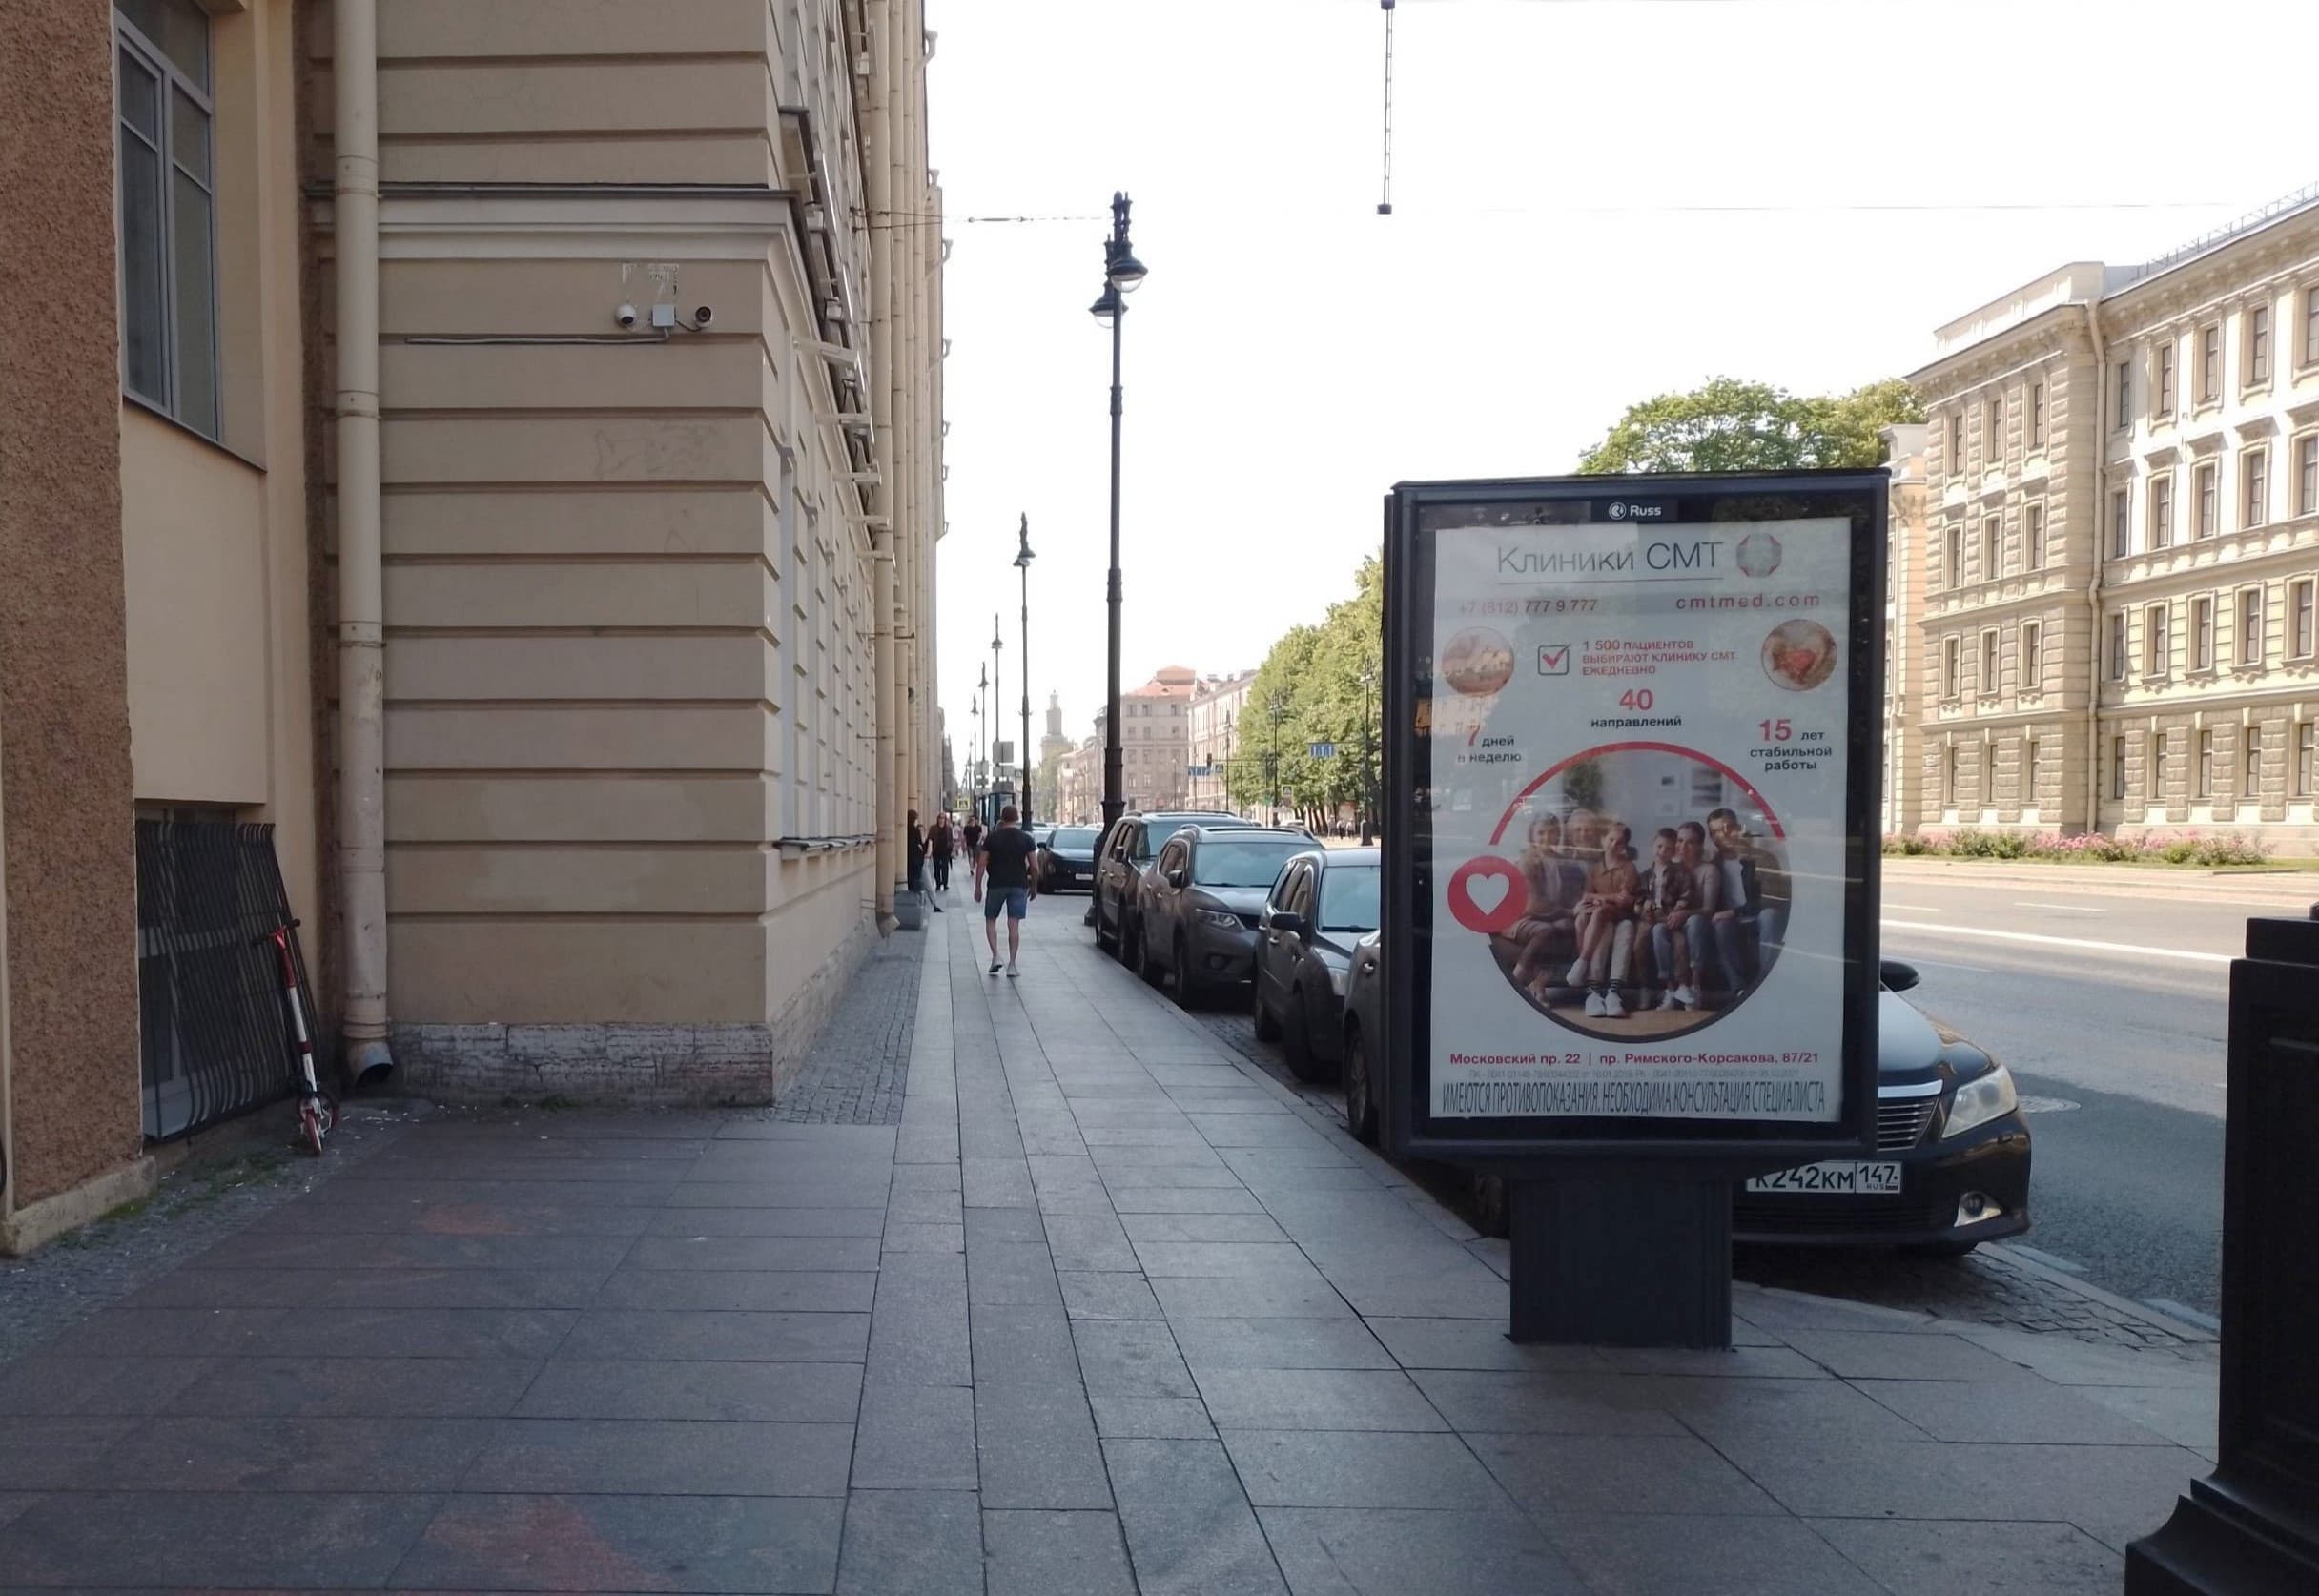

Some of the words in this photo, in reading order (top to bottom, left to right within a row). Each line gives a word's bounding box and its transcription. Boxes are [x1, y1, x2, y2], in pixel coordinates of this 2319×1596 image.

[1630, 505, 1662, 517] Russ
[1498, 546, 1634, 573] Клиники
[1646, 542, 1723, 570] СМТ
[1526, 601, 1550, 612] 777
[1556, 600, 1566, 612] 9
[1571, 599, 1598, 611] 777
[1675, 594, 1820, 610] cmtmed.com
[1595, 640, 1621, 650] 500
[1623, 640, 1694, 652] ПАЦИЕНТОВ
[1582, 654, 1649, 664] ВЫБИРАЮТ
[1652, 652, 1708, 663] КЛИНИКУ
[1711, 651, 1736, 661] СМТ
[1582, 666, 1656, 676] ЕЖЕДНЕВНО
[1619, 688, 1653, 711] 40
[1590, 715, 1682, 729] направлений
[1467, 722, 1481, 746] 7
[1482, 735, 1515, 747] дней
[1759, 719, 1792, 741] 15
[1800, 731, 1825, 741] лет
[1750, 746, 1832, 757] стабильной
[1469, 753, 1522, 764] неделю
[1764, 760, 1817, 773] работы
[1450, 1053, 1536, 1065] Московский
[1541, 1056, 1561, 1066] пр.
[1565, 1054, 1580, 1064] 22
[1600, 1056, 1621, 1066] пр.
[1625, 1053, 1778, 1065] Римского-Корсакова,
[1783, 1053, 1818, 1063] 87/21
[1443, 1083, 1491, 1113] ИМЕЮТСЯ
[1494, 1083, 1600, 1114] ПРОТИВОПОКАЗАНИЯ.
[1604, 1082, 1671, 1115] НЕОБХОДИМА
[1674, 1081, 1750, 1114] КОНСУЛЬТАЦИЯ
[1754, 1081, 1825, 1114] СПЕЦИАЛИСТА
[1859, 1165, 1896, 1182] 147
